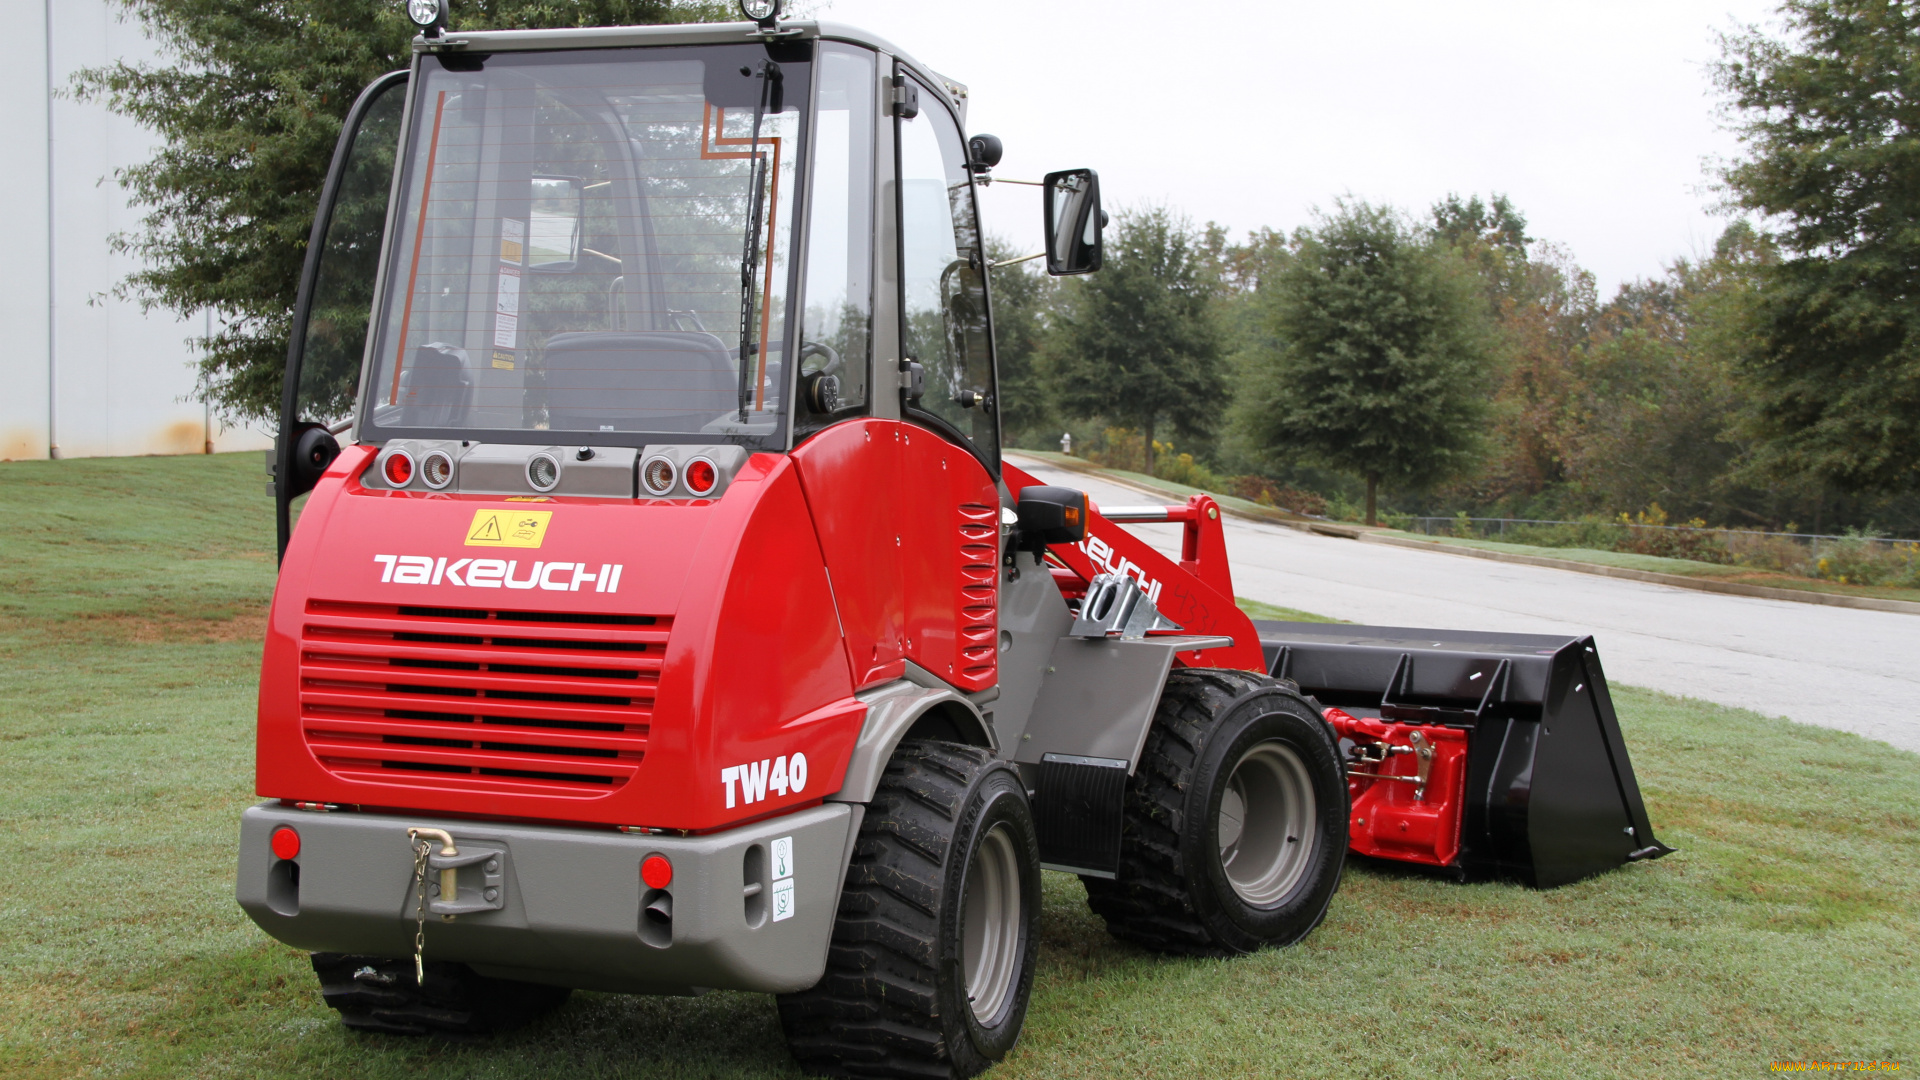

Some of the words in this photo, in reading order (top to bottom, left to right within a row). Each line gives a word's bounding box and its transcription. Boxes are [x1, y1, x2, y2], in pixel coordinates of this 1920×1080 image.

[374, 554, 623, 593] TAKEUCHI
[1174, 584, 1217, 635] 4331
[721, 752, 808, 809] TW40
